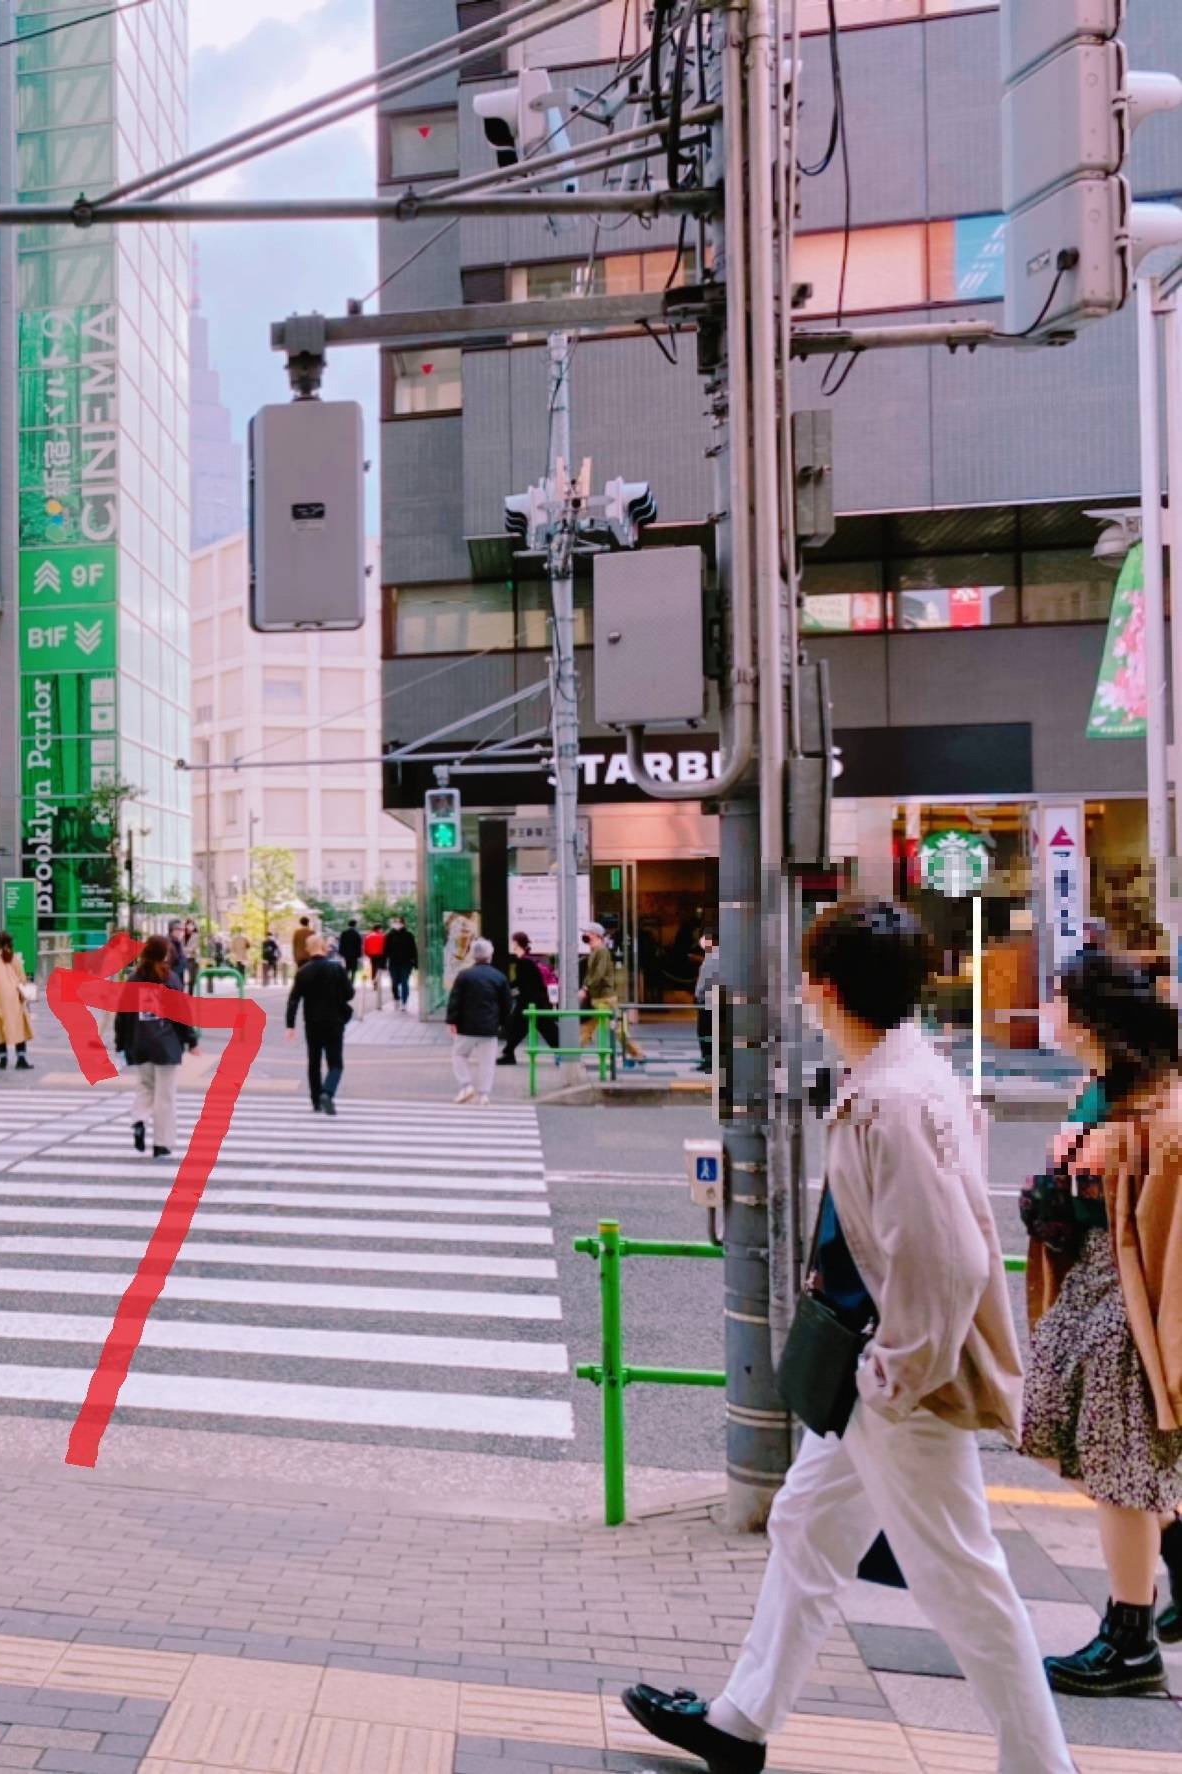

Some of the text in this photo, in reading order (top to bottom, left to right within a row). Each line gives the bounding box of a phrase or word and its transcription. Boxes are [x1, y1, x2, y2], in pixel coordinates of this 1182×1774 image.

[40, 311, 75, 497] 新宿バルト9
[80, 303, 117, 542] CINEMA
[71, 564, 104, 588] 9F
[28, 626, 68, 648] B1F
[28, 679, 52, 768] Parlor
